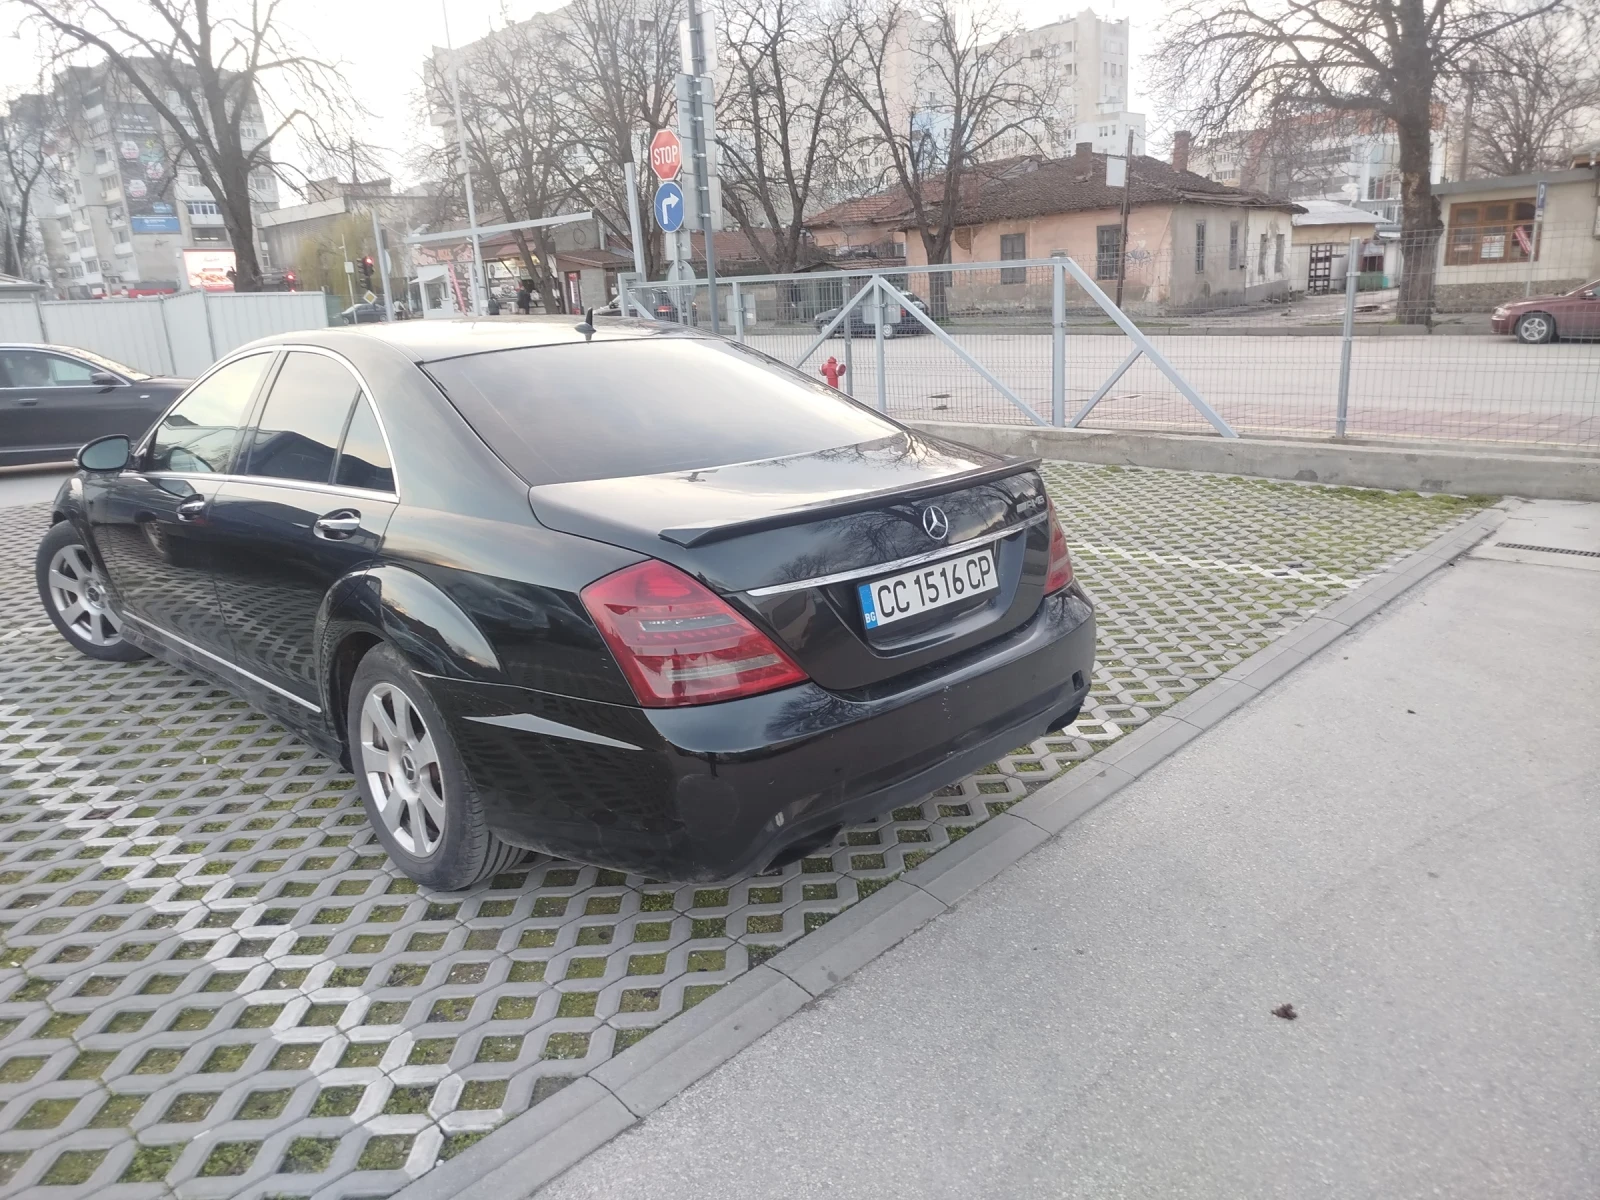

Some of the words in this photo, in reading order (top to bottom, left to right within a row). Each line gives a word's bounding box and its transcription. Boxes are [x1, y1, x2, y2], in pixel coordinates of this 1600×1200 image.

[653, 145, 678, 165] STOP
[1025, 495, 1045, 509] AMG
[877, 580, 910, 618] CC
[914, 563, 965, 606] 1516
[966, 555, 991, 590] CP
[864, 611, 877, 624] BG
